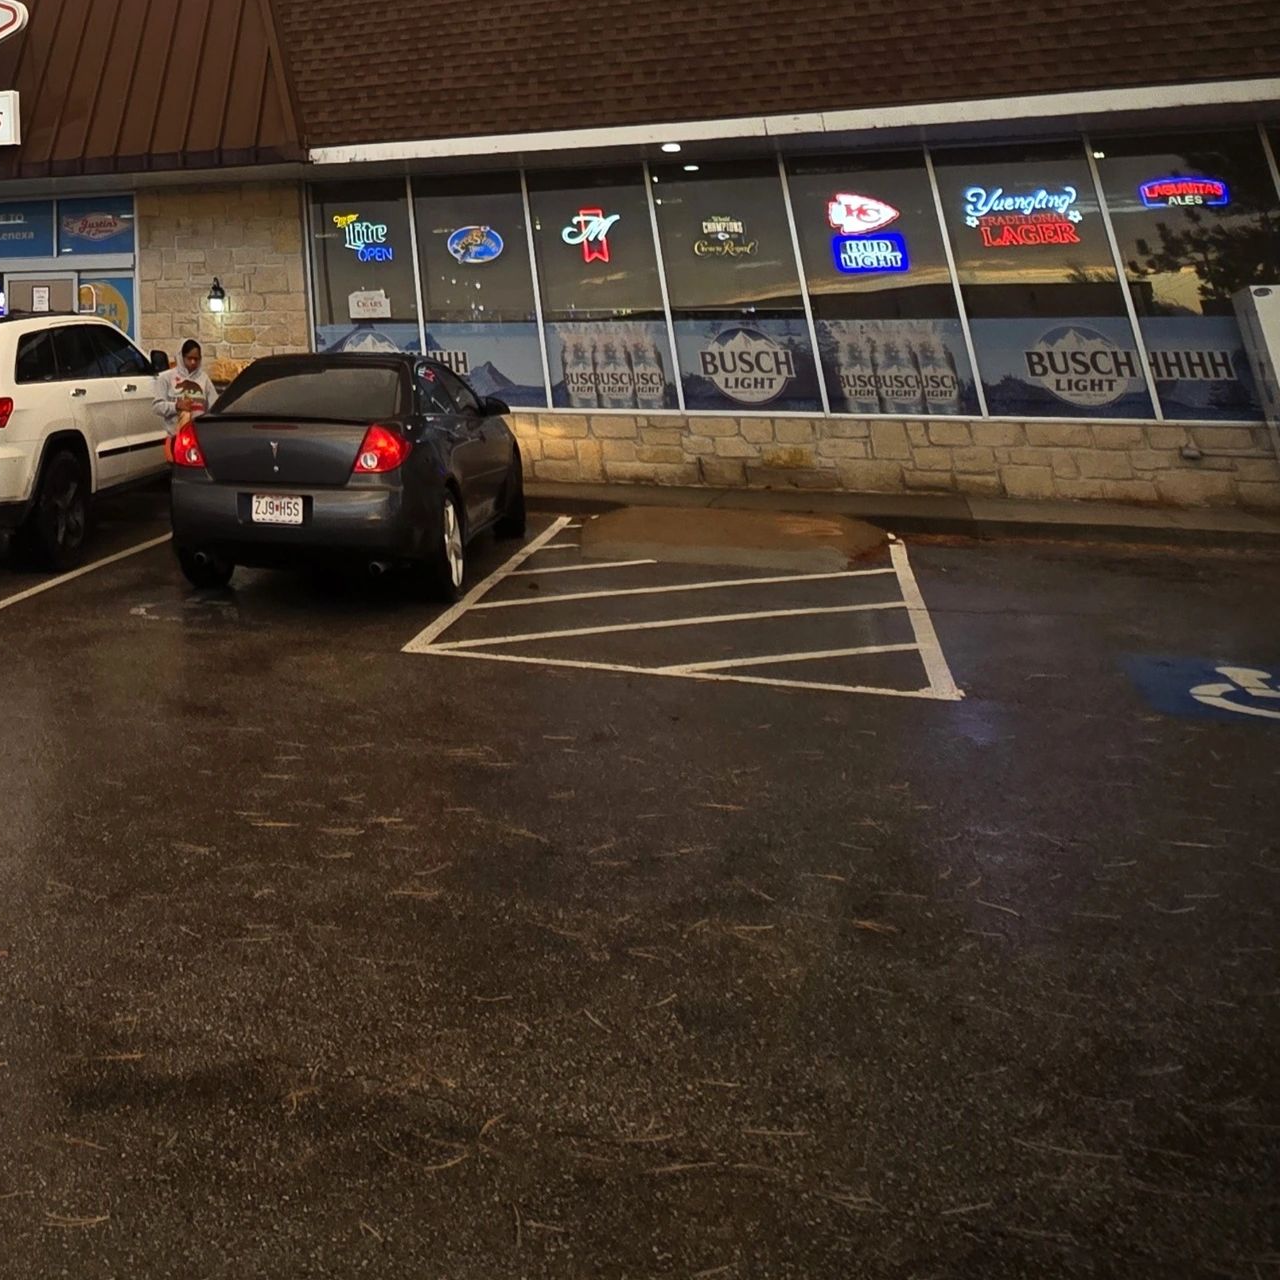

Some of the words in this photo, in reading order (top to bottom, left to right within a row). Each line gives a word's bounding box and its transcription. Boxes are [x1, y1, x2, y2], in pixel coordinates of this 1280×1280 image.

[965, 186, 1077, 216] Yuengling
[1167, 195, 1203, 205] ALES
[9, 213, 24, 224] TO
[978, 213, 1069, 226] TRADITIONAL
[345, 222, 388, 251] Lite
[981, 223, 1081, 247] LAGER
[846, 240, 892, 253] BUD
[358, 247, 394, 262] OPEN
[841, 252, 902, 268] LIGHT
[700, 350, 794, 376] BUSCH
[1025, 350, 1138, 377] BUSCH
[602, 385, 630, 393] LIGHT
[724, 377, 777, 390] LIGHT
[1055, 379, 1117, 392] LIGHT
[885, 389, 917, 397] LIGHT
[927, 389, 953, 397] IGHT
